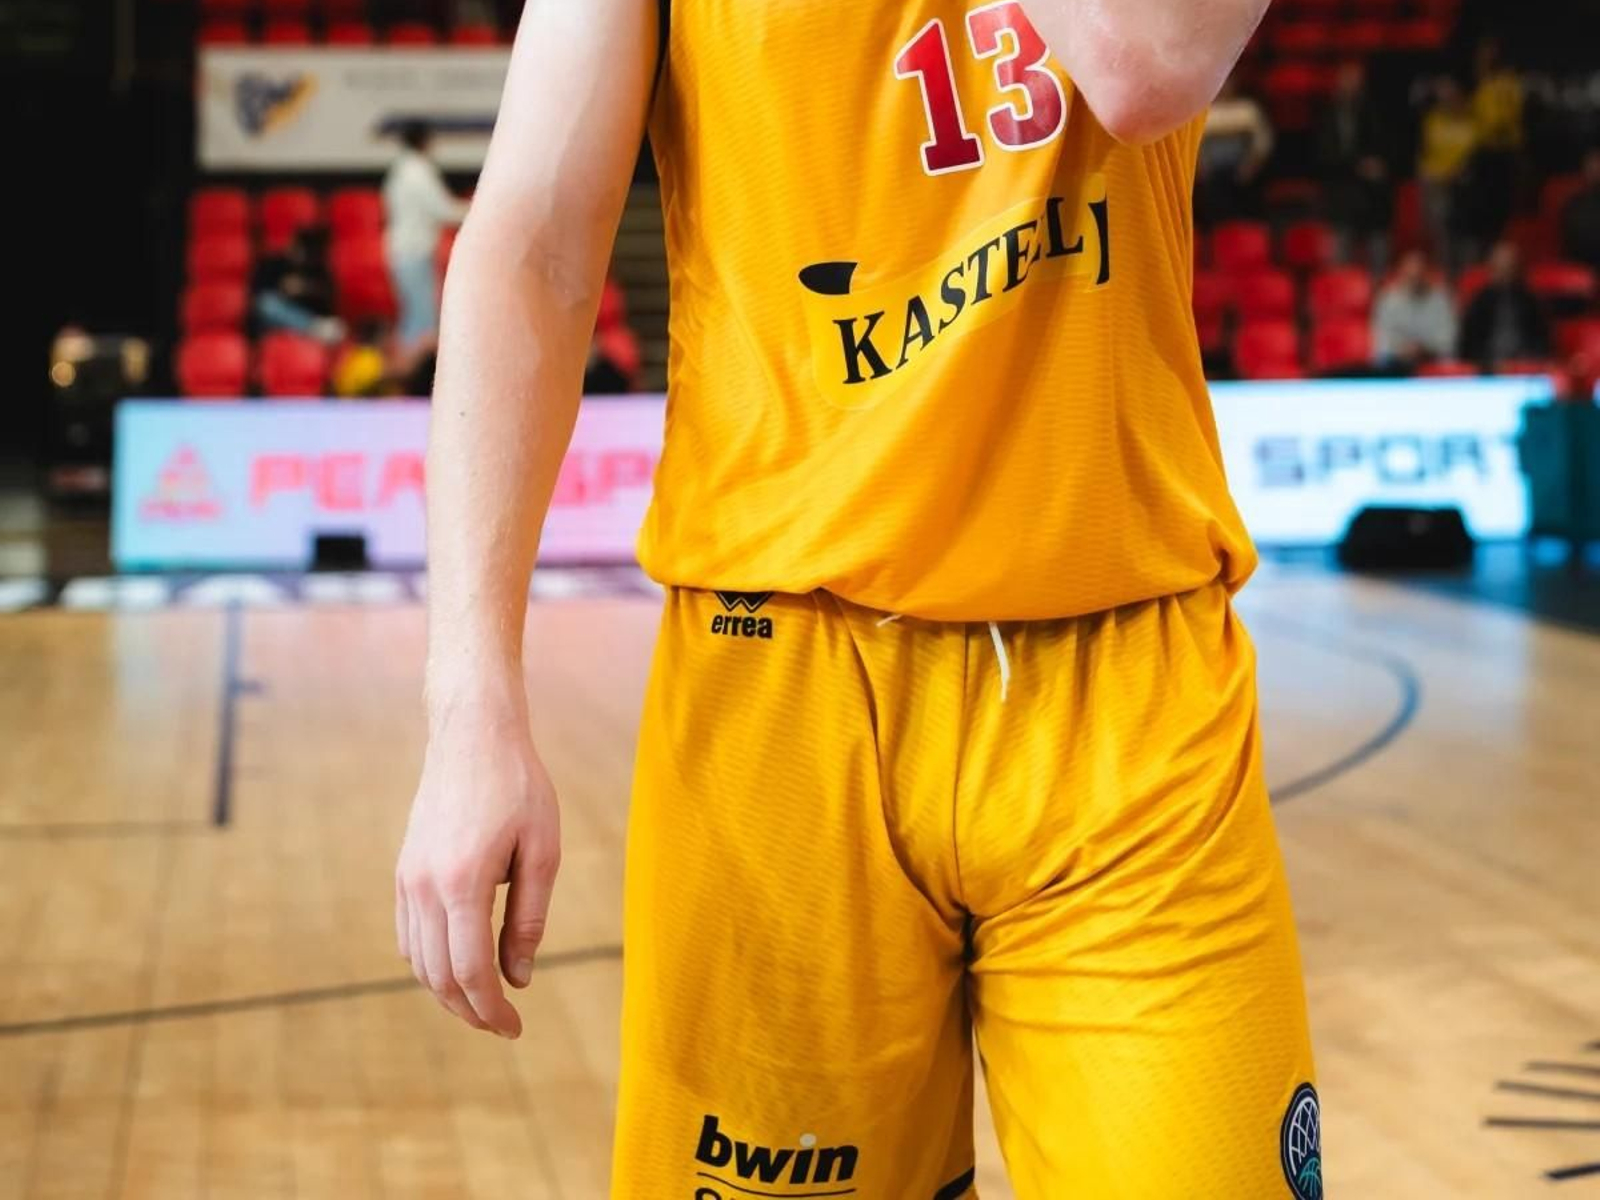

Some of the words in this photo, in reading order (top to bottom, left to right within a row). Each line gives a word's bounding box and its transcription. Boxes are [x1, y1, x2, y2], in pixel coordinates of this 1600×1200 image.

[1256, 433, 1519, 486] SPOR
[711, 615, 773, 639] errea
[695, 1114, 859, 1185] bwin
